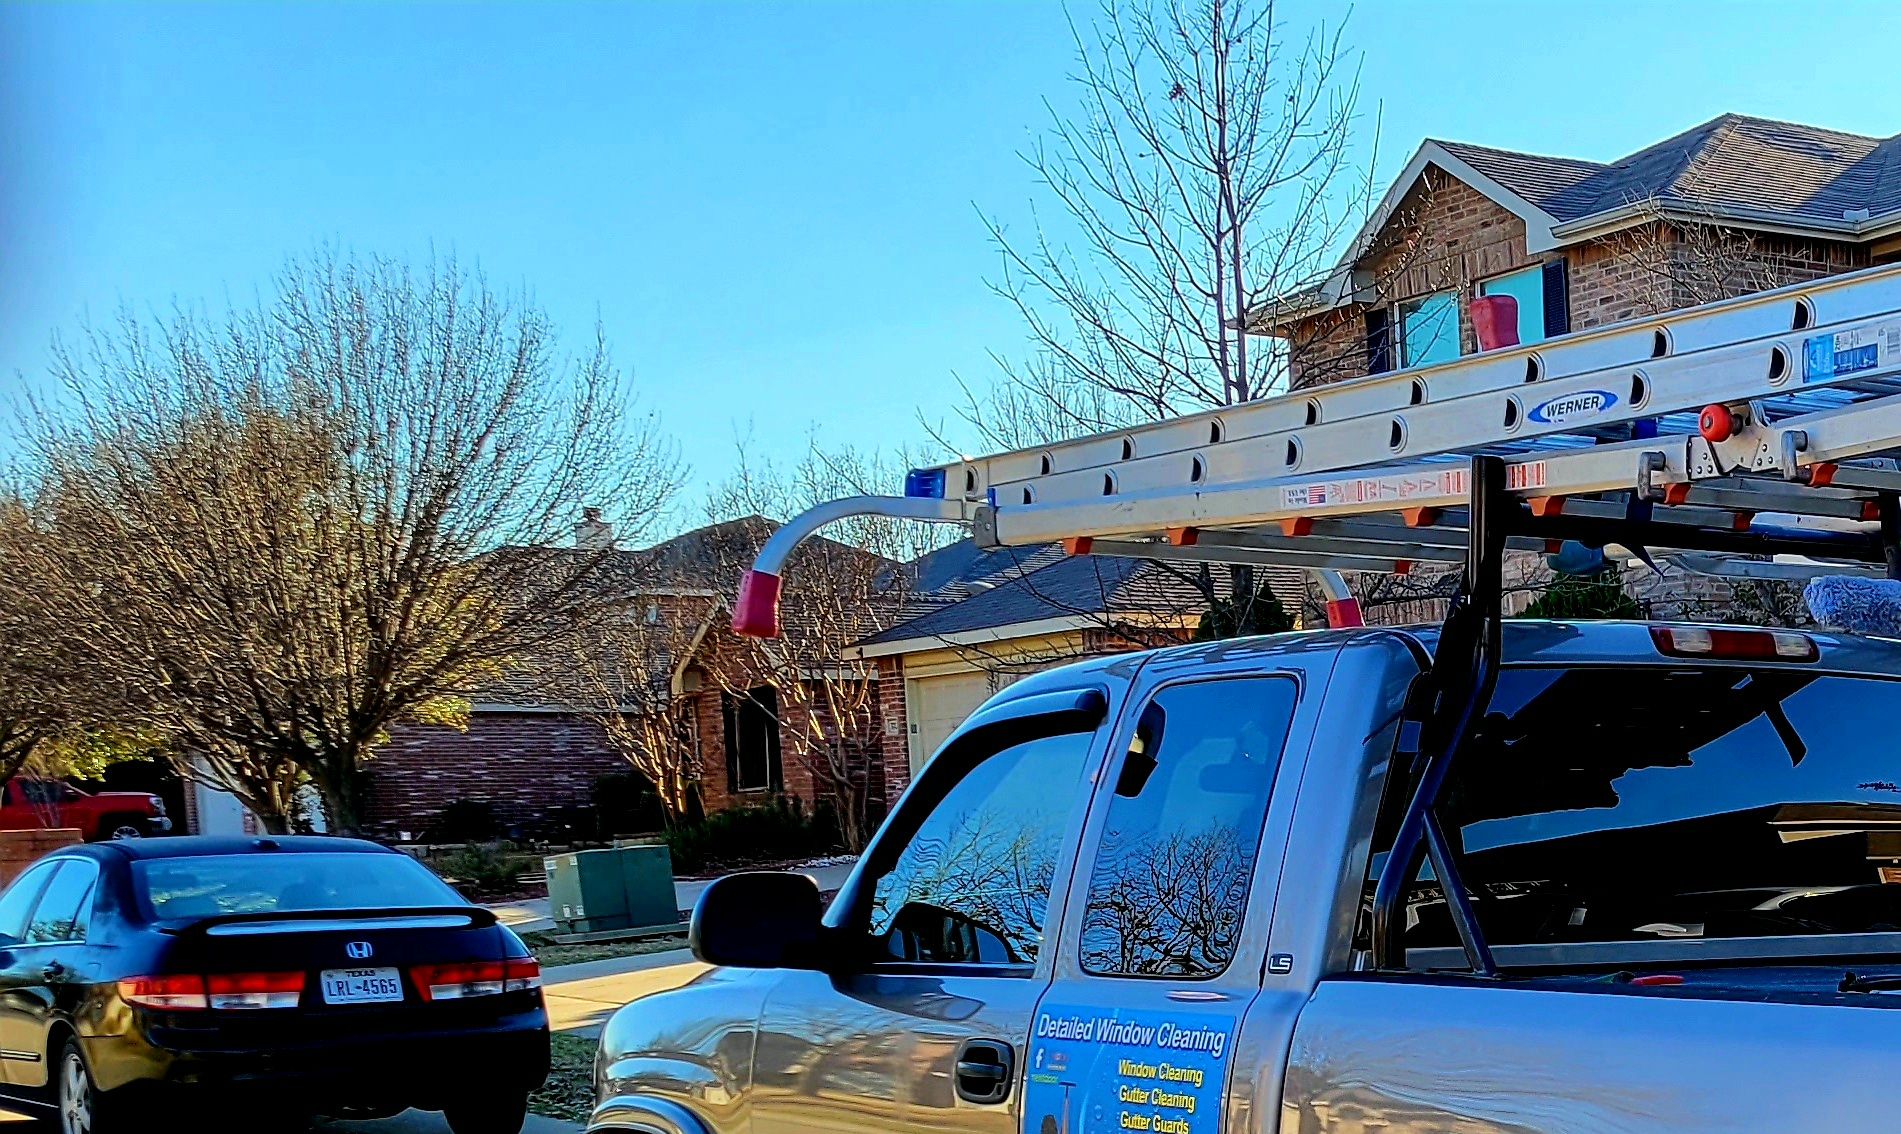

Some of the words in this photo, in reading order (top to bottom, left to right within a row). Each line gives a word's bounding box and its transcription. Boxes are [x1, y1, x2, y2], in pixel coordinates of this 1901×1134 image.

[1546, 396, 1600, 418] WERNER
[1270, 957, 1291, 970] LS
[327, 979, 397, 997] LRL-4565
[1037, 1014, 1096, 1041] Detailed
[1096, 1018, 1155, 1046] Window
[1156, 1022, 1227, 1057] Cleaning
[1118, 1059, 1157, 1078] Window
[1158, 1064, 1204, 1087] Cleaning
[1119, 1086, 1150, 1105] Gutter
[1151, 1089, 1195, 1113] Cleaning
[1120, 1111, 1151, 1131] Gutter
